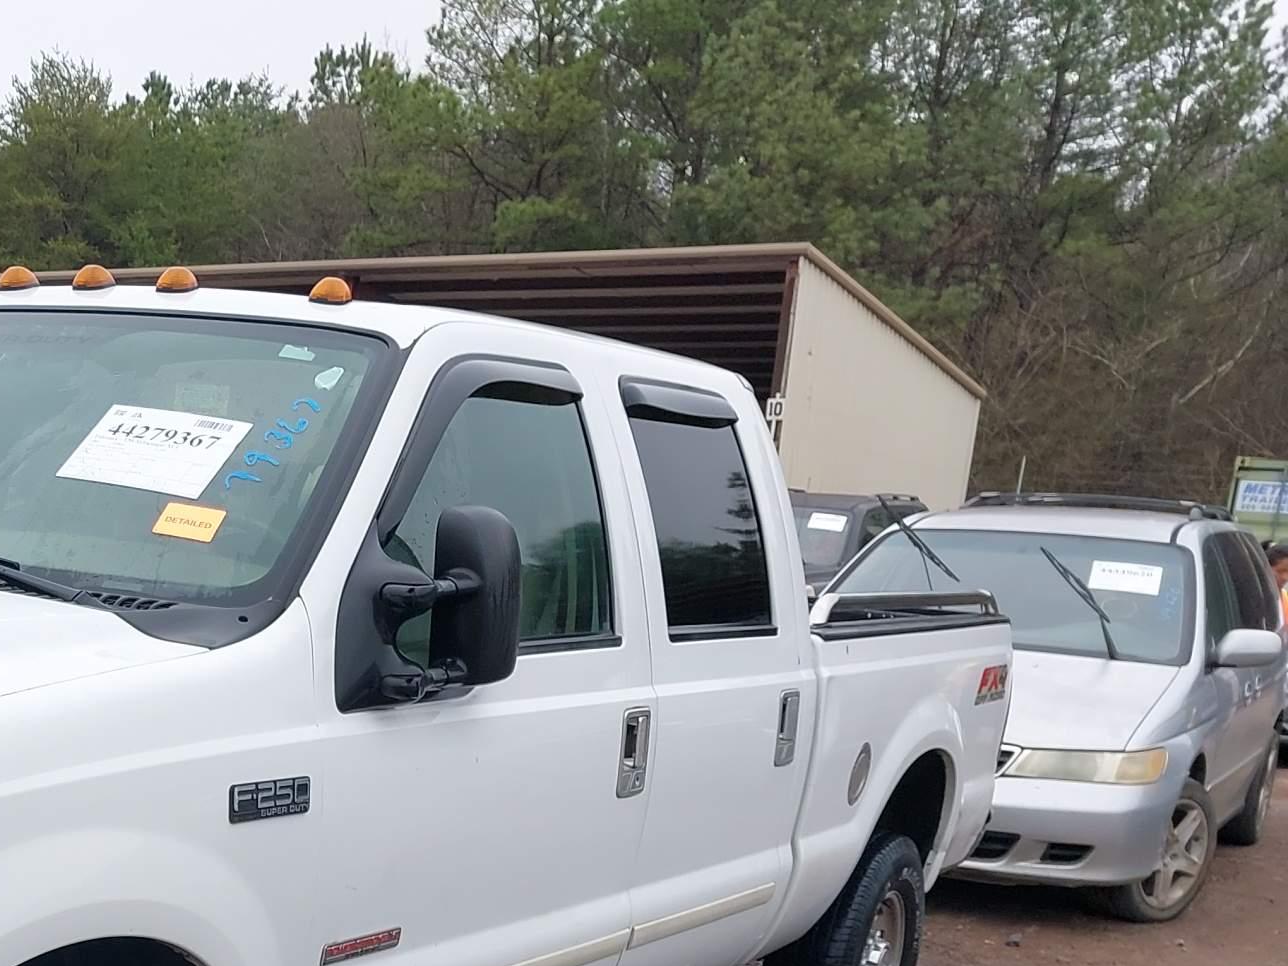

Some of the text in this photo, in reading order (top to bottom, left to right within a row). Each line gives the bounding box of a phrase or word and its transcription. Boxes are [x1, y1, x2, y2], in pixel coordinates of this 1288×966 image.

[769, 401, 783, 417] 10
[108, 423, 223, 450] 44279367
[164, 515, 213, 530] DETAILED
[260, 803, 310, 817] SUPER DUTY
